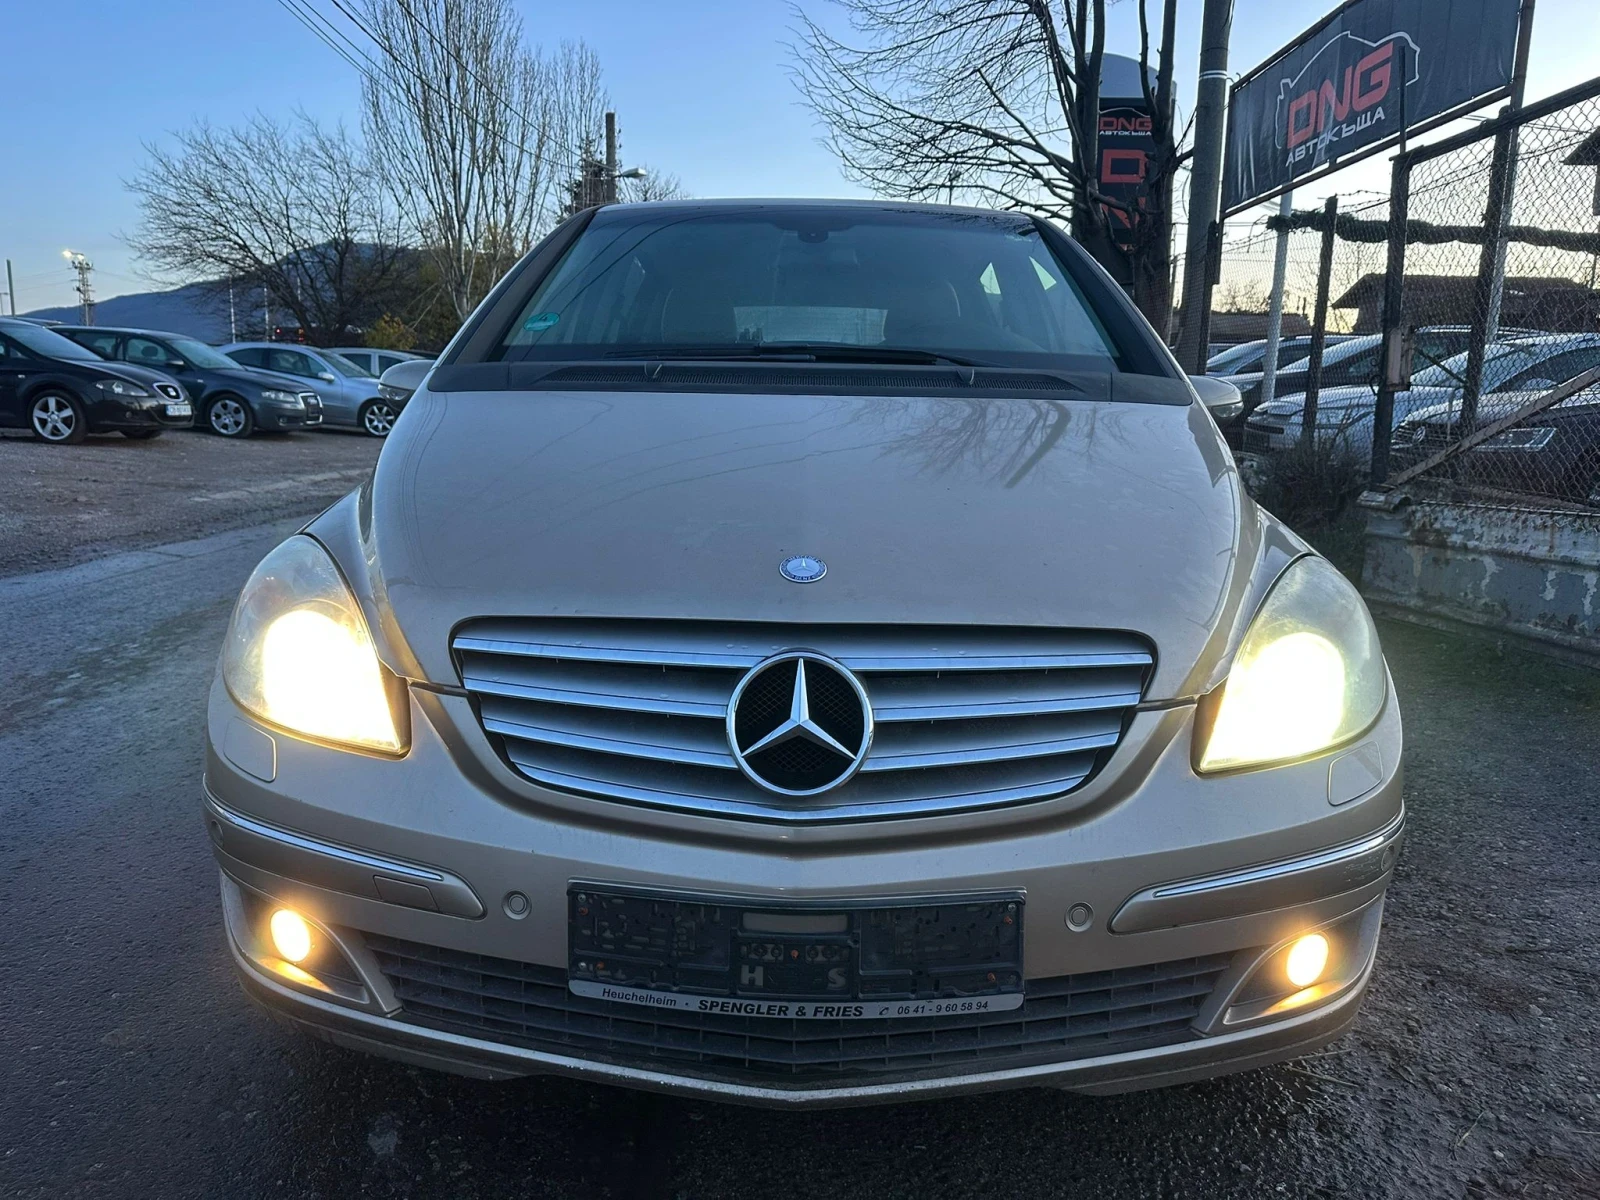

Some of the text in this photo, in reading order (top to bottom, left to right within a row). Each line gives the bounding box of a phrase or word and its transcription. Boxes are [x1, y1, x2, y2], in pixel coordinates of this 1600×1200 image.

[1287, 41, 1393, 149] DNG
[1099, 117, 1153, 131] DNG
[602, 988, 677, 1006] Heuchelheim
[698, 999, 790, 1017] SPENGLER
[795, 1006, 807, 1017] &
[813, 1006, 864, 1017] FRIES
[897, 1006, 910, 1015] 06
[912, 1005, 926, 1014] 41
[936, 1004, 942, 1013] 9
[945, 1003, 958, 1012] 60
[960, 1002, 974, 1011] 58
[976, 1001, 989, 1010] 94
